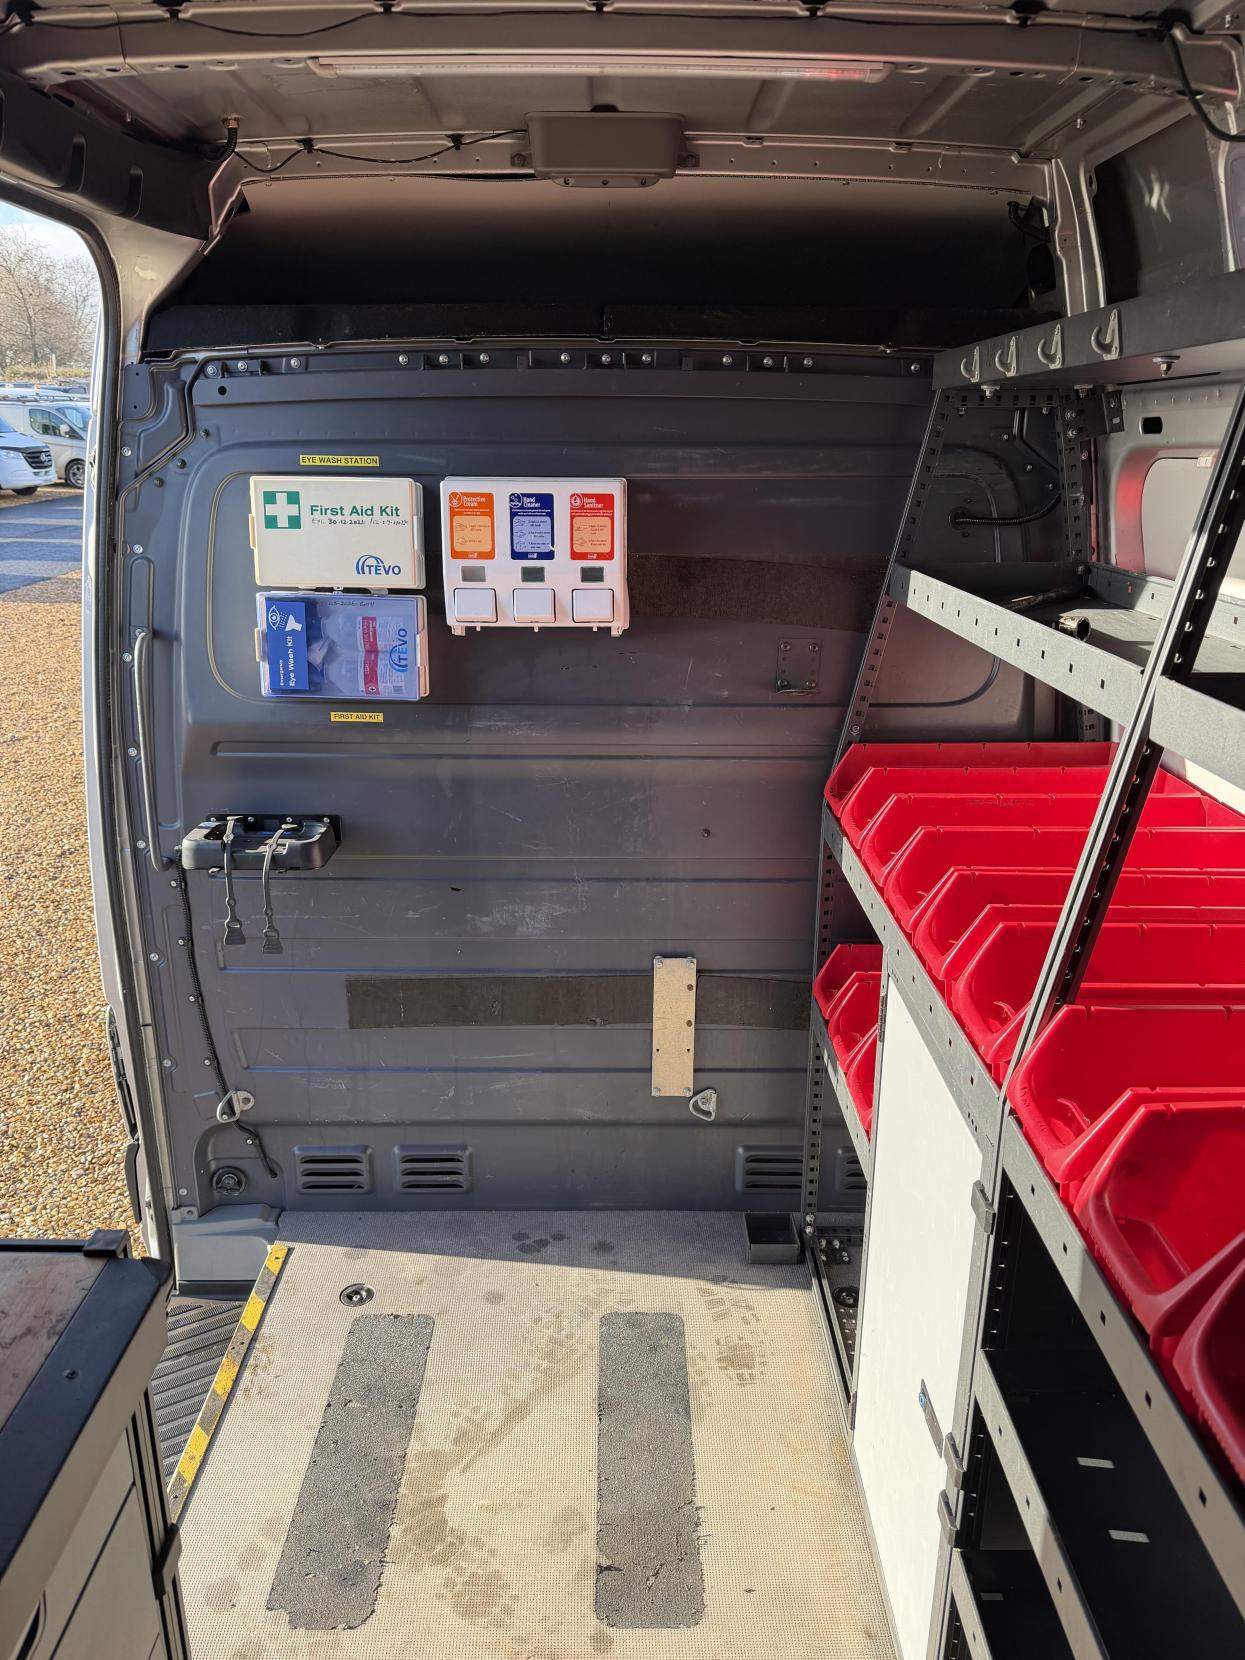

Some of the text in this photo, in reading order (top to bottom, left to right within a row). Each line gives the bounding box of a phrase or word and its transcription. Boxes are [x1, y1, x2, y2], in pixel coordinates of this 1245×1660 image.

[344, 457, 378, 465] STATION
[310, 505, 400, 517] First Aid Kit
[398, 628, 408, 662] TEVO
[289, 671, 297, 687] Eye
